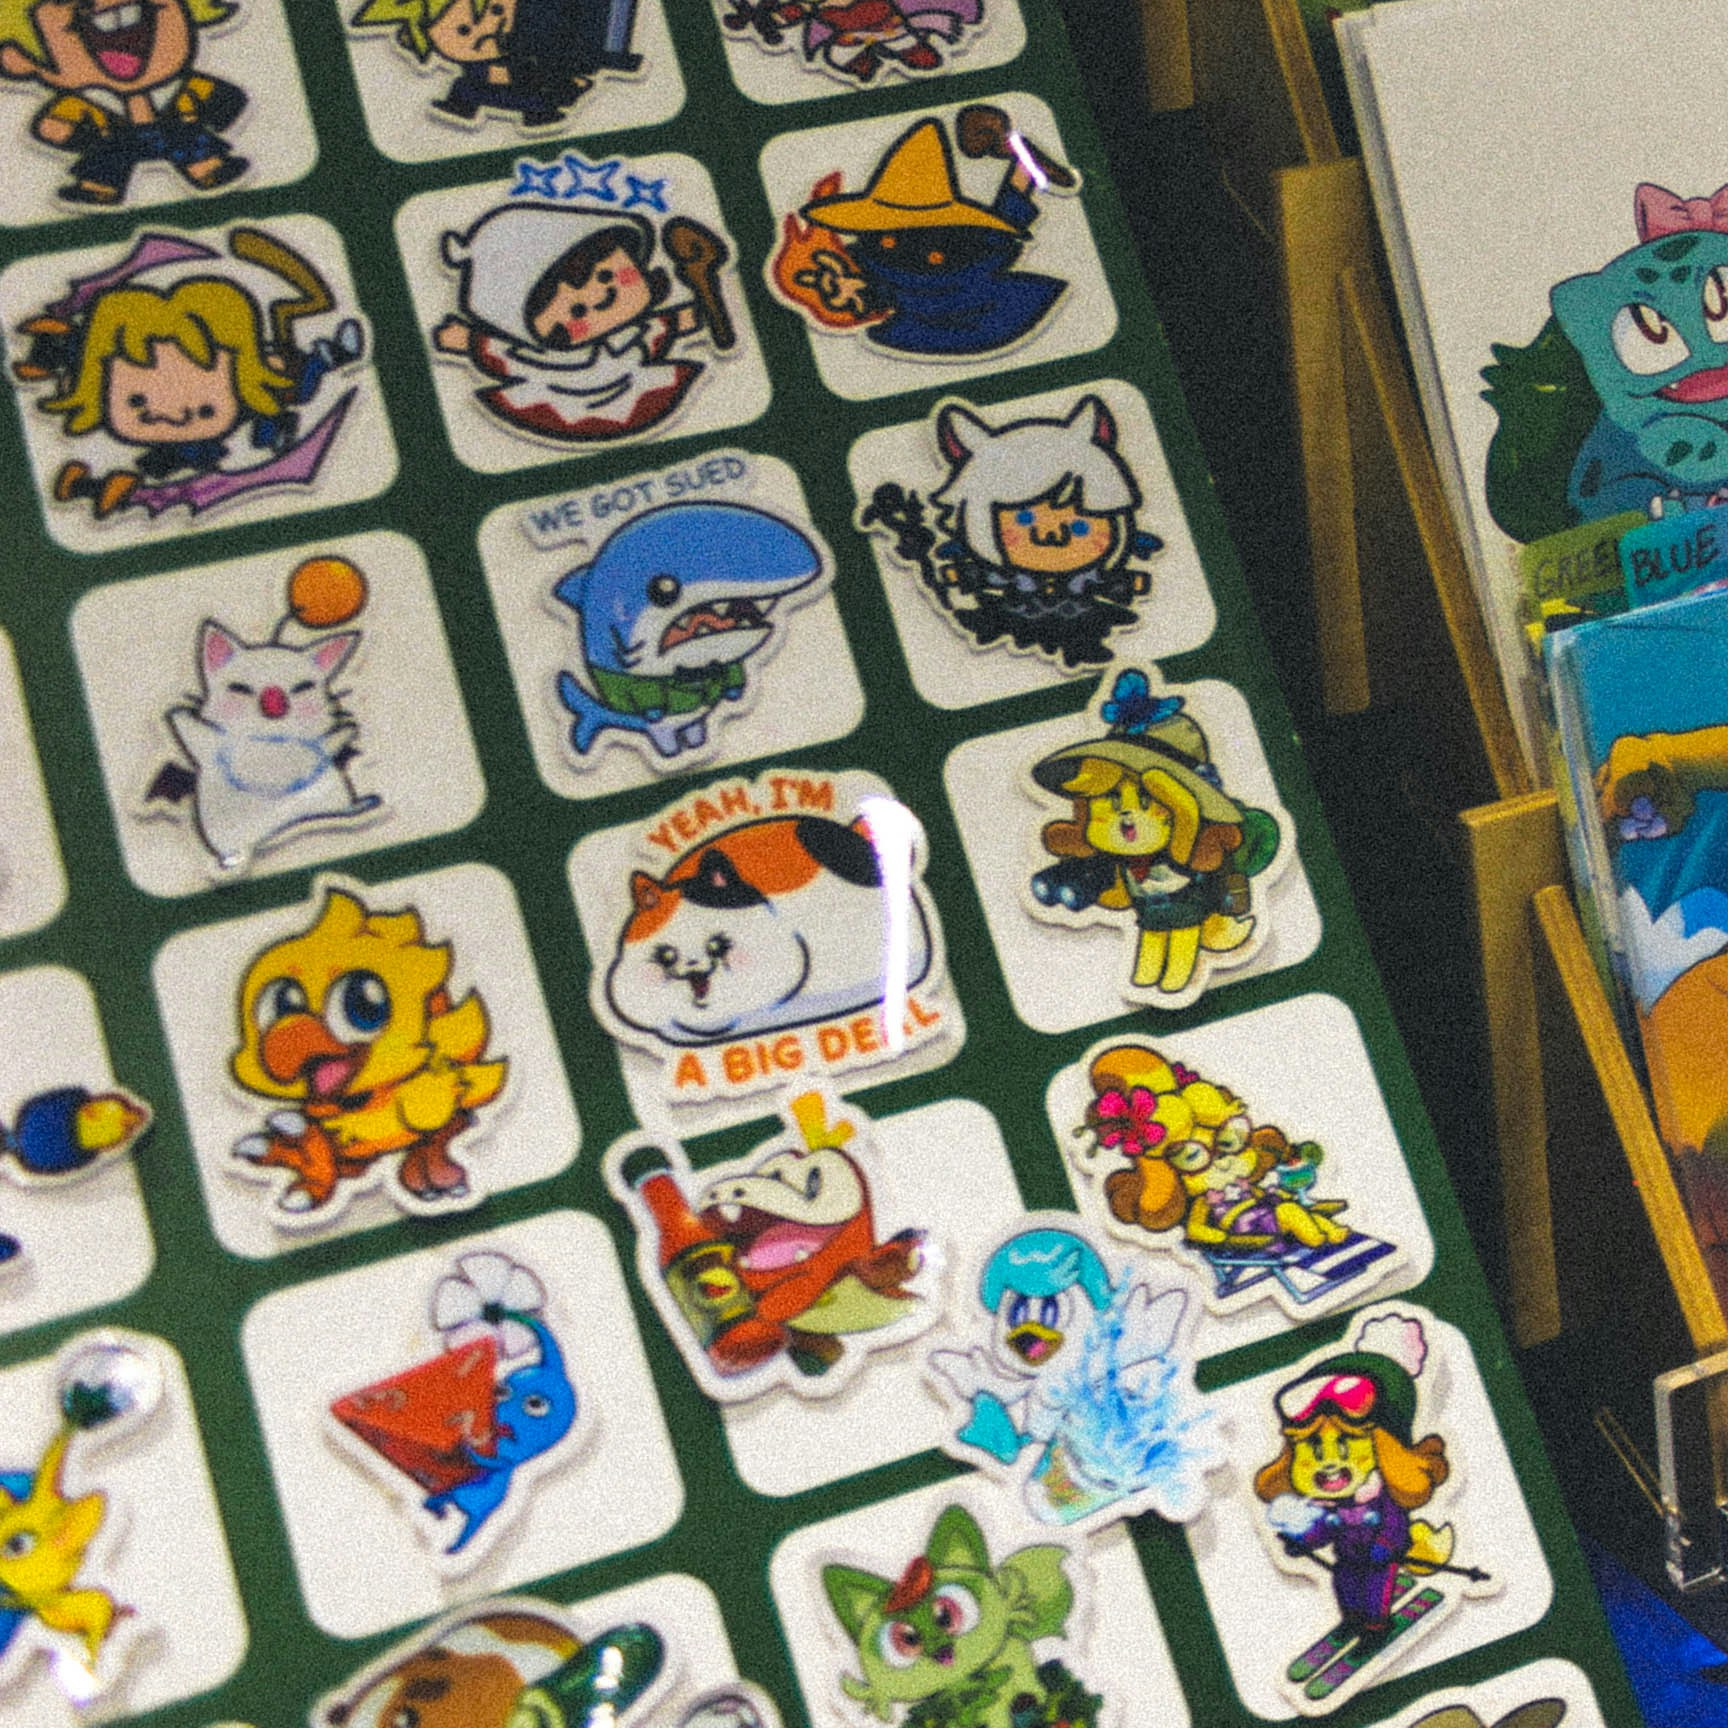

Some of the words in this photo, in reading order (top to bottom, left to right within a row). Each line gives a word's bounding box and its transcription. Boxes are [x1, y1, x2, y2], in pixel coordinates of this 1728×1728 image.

[527, 499, 584, 532] WE
[588, 479, 656, 519] GOT
[663, 455, 748, 498] SUED
[1628, 521, 1722, 590] BLUE
[645, 784, 762, 854] YEAH,
[768, 775, 837, 815] I'M
[674, 1050, 708, 1090] A
[720, 1032, 806, 1086] BIG
[814, 994, 942, 1066] DEL
